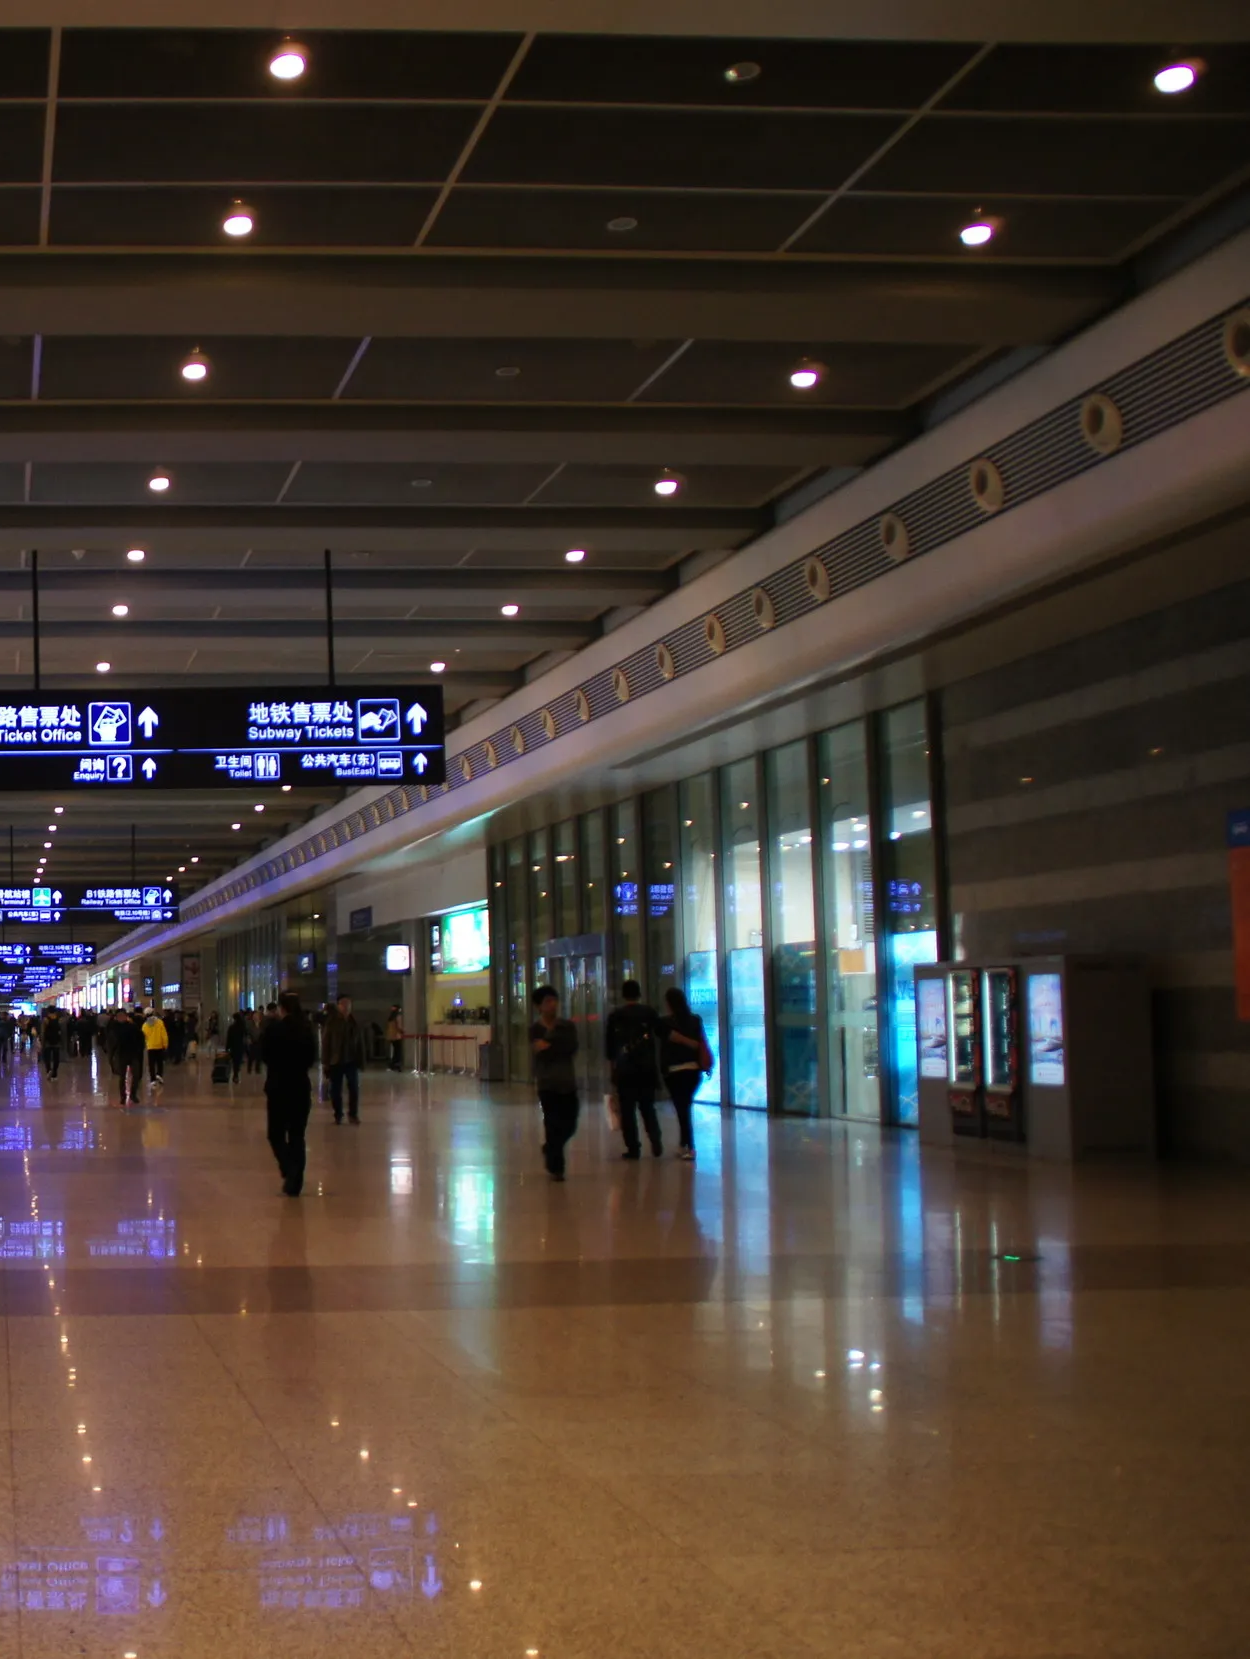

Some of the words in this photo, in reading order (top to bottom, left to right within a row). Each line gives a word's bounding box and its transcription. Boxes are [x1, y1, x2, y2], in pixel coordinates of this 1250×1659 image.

[248, 701, 354, 724] 地铁售票处
[40, 728, 82, 742] Office
[248, 727, 302, 742] Subway
[305, 725, 355, 739] Tickets
[79, 757, 105, 772] 问询
[215, 755, 253, 769] 卫生间
[73, 771, 105, 782] Enquiry
[229, 769, 253, 778] Toilet
